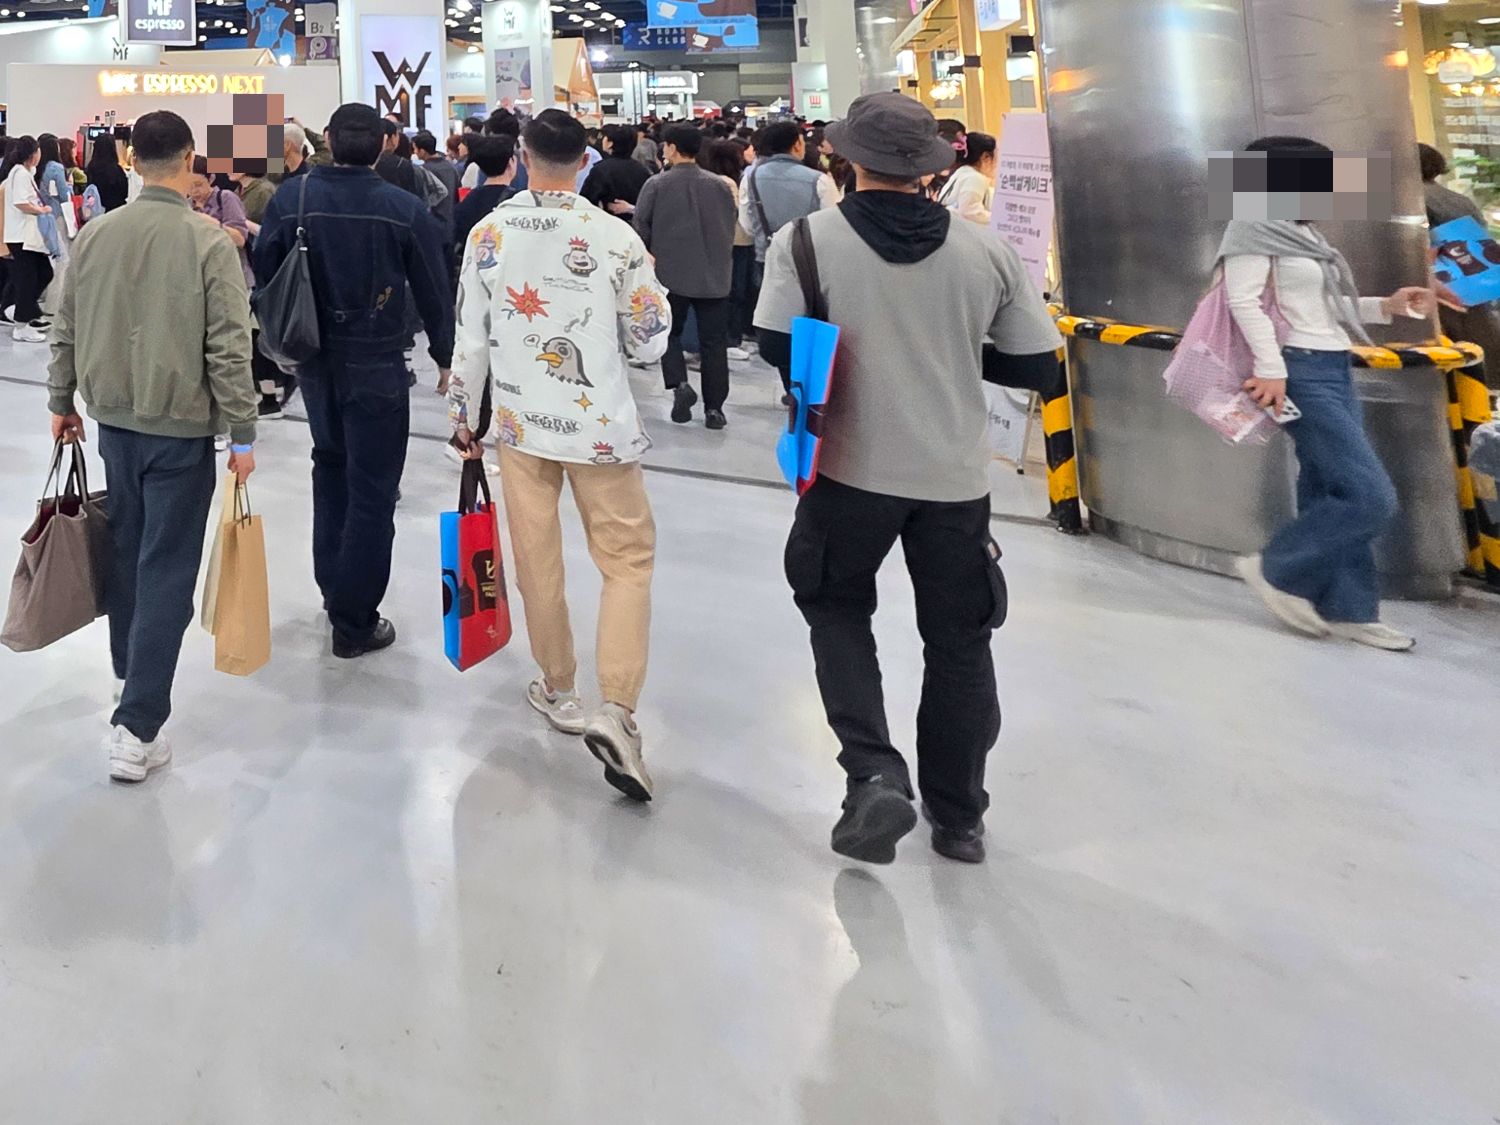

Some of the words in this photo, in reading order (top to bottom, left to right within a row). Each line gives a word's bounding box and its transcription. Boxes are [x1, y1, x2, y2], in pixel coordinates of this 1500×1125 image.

[135, 19, 185, 32] espresso
[657, 36, 686, 44] CLUB
[143, 73, 218, 94] ESPRESSO
[223, 75, 265, 94] NEXT
